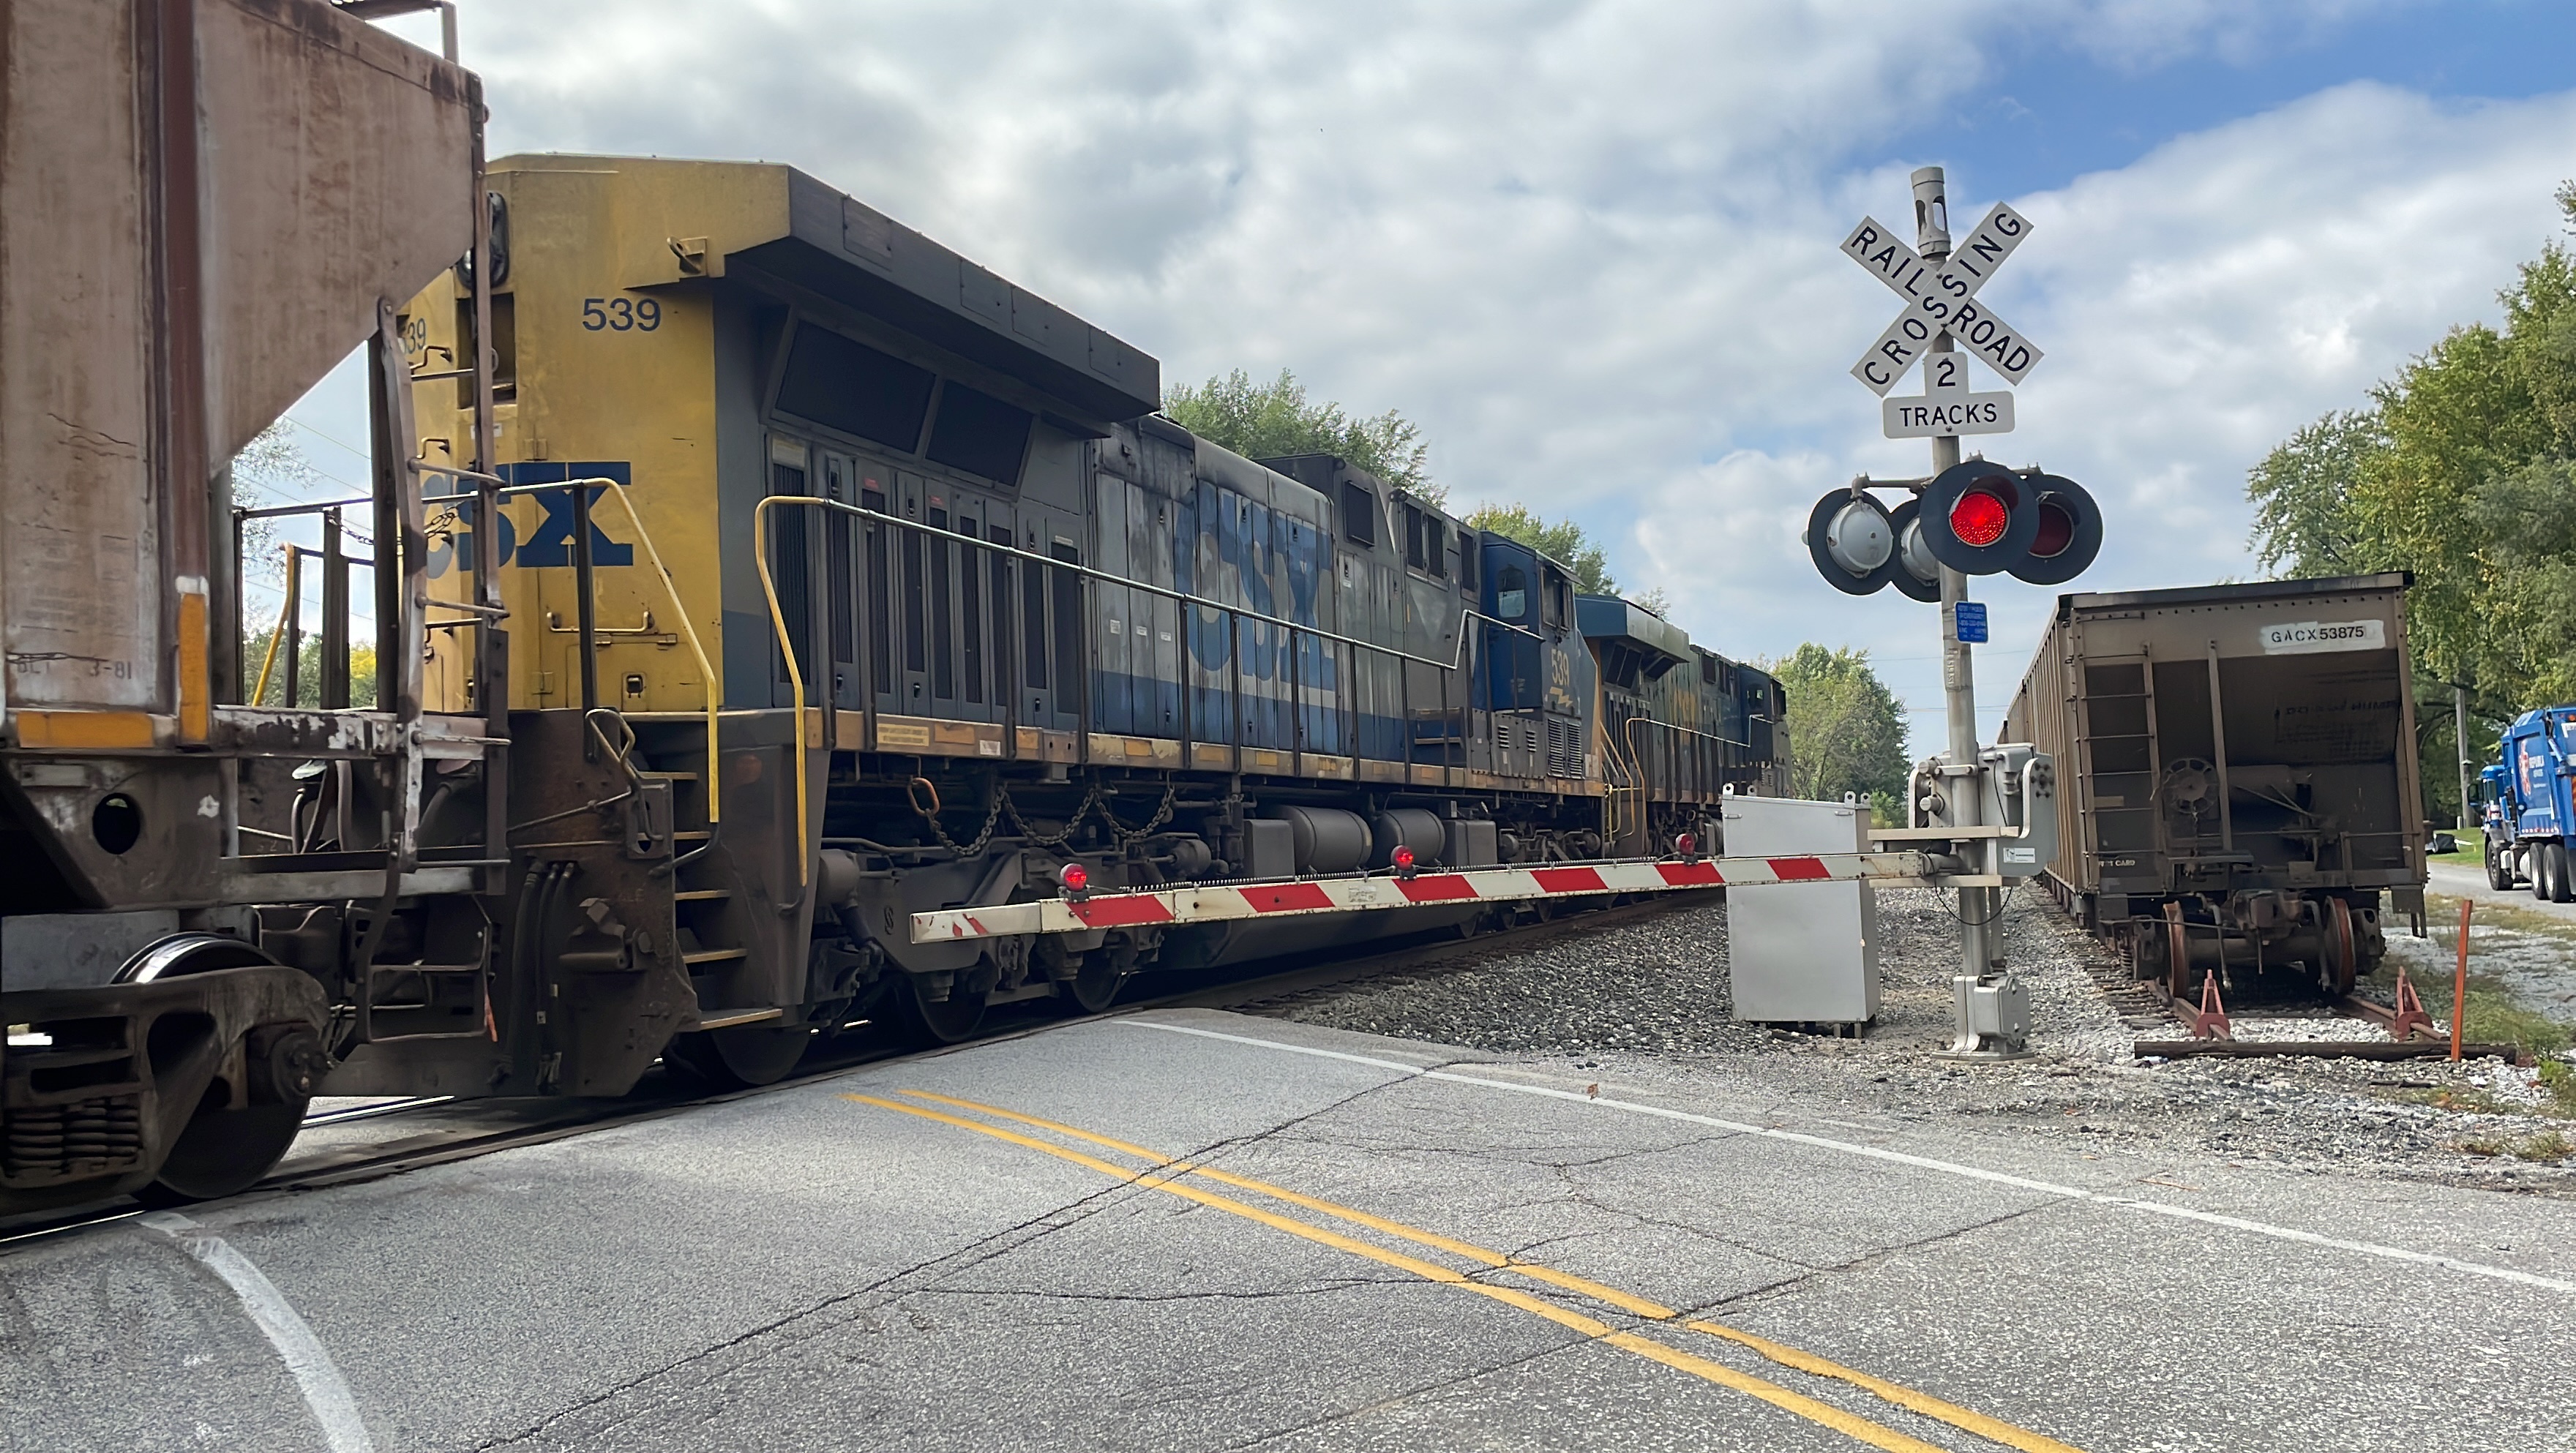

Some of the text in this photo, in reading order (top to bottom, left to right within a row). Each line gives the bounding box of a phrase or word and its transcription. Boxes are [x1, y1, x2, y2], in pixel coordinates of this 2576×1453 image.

[582, 297, 661, 332] 539
[1863, 213, 2021, 385] CROSSING
[404, 318, 426, 354] 39
[1936, 361, 1956, 387] 2
[1899, 402, 1997, 427] TRACKS
[1174, 479, 1336, 694] CSX
[1551, 648, 1570, 688] 539
